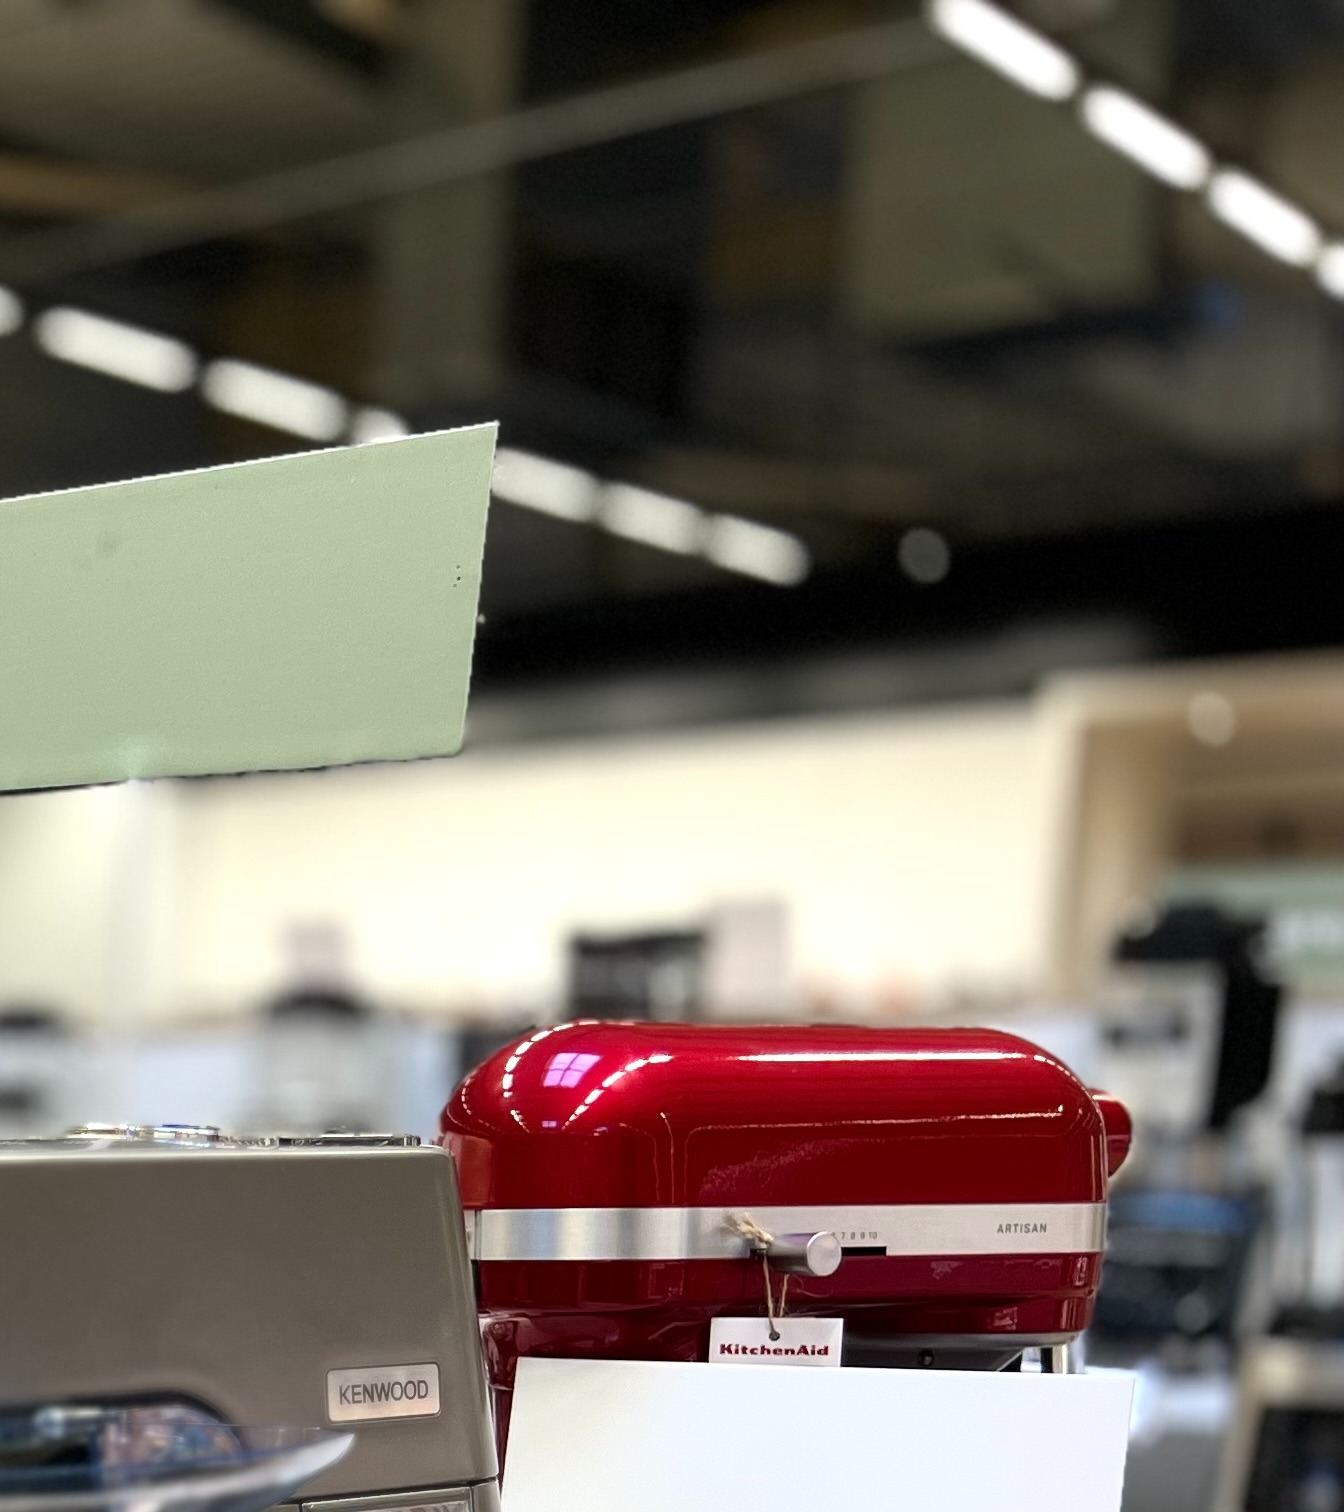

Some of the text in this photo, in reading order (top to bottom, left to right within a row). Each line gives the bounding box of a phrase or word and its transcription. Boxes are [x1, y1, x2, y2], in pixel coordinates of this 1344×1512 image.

[996, 1223, 1048, 1234] ARTISAN
[719, 1343, 829, 1356] KitchenAid
[339, 1379, 429, 1405] KENWOOD
